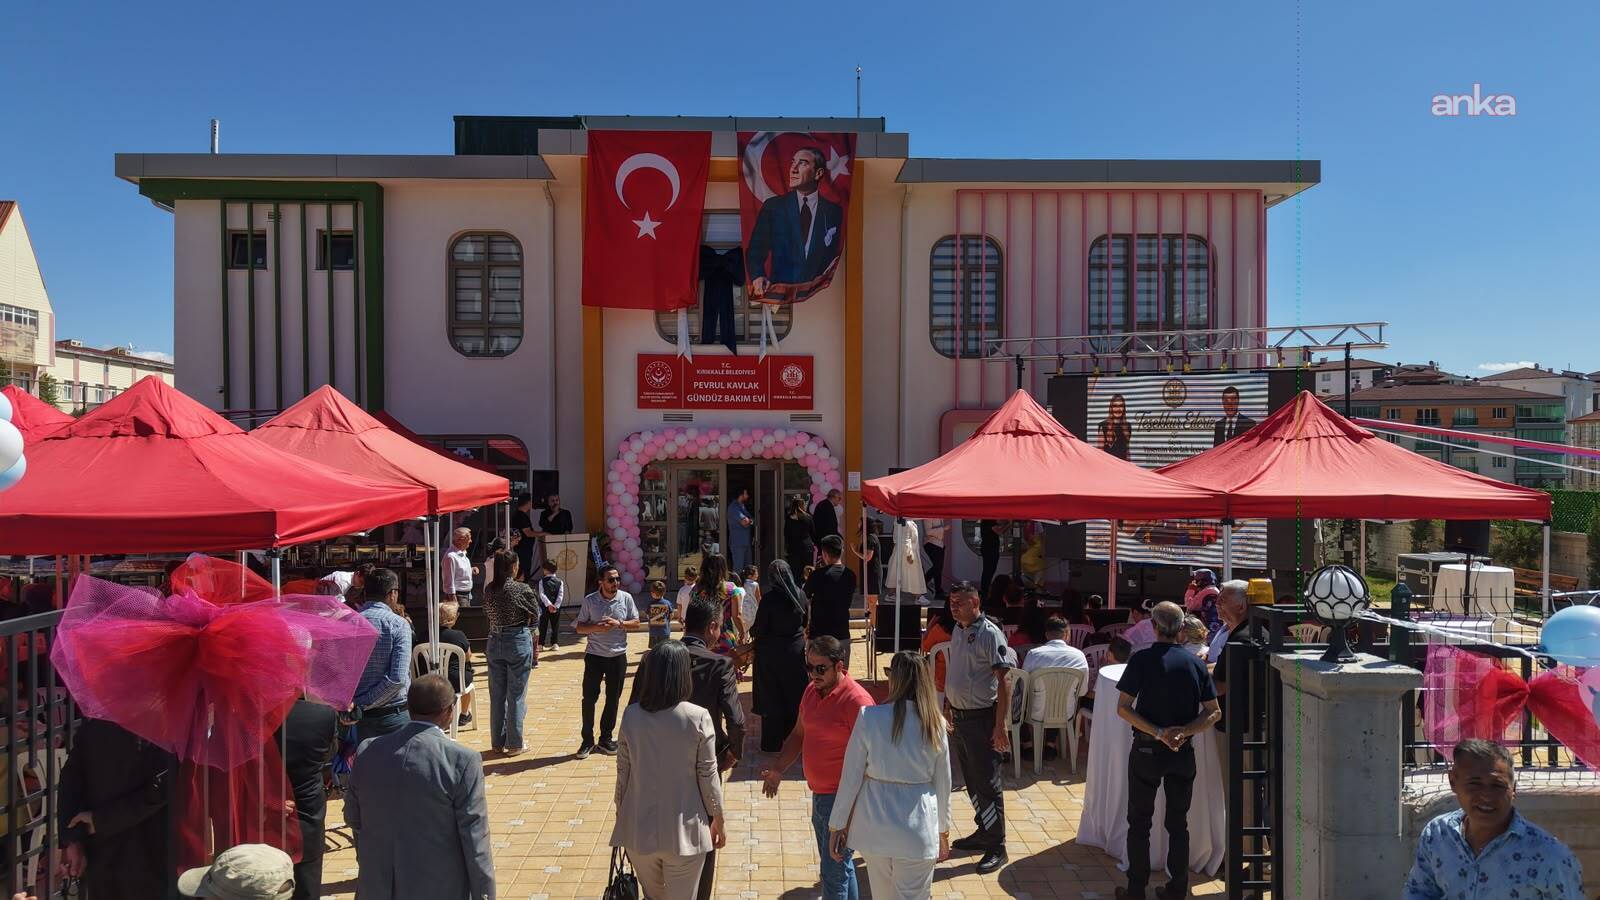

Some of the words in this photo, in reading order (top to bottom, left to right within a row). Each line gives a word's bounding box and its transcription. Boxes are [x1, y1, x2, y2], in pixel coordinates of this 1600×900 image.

[693, 381, 726, 390] PEVRUL
[726, 382, 760, 390] KAVLAK
[686, 392, 724, 402] GÜNDÜZ
[725, 394, 752, 402] BAKIM
[752, 394, 767, 403] EVİ
